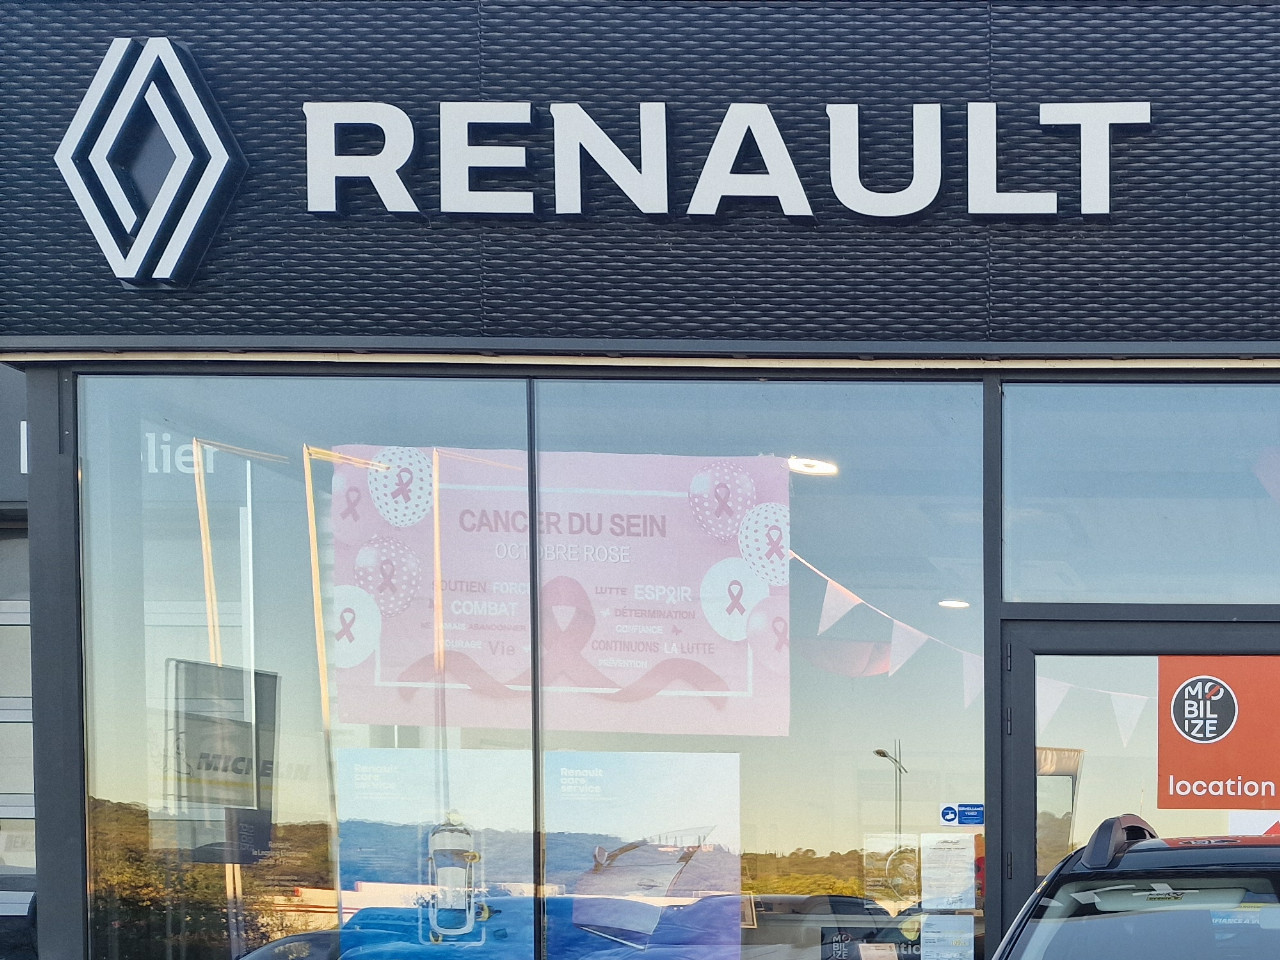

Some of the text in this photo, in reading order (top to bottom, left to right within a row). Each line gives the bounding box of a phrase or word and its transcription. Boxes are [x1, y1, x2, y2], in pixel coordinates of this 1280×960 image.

[303, 102, 1151, 217] RENAULT
[141, 432, 219, 474] lier
[458, 508, 667, 538] CANCER DU SEIN
[584, 544, 632, 563] ROSE
[595, 586, 628, 596] LUTTE
[451, 600, 519, 616] COMBAT
[615, 605, 696, 620] DÉTERMINATION
[615, 624, 664, 635] CONFIANCE
[488, 639, 516, 657] Vie
[591, 639, 715, 655] CONTINUONS LA LUTTE
[560, 767, 603, 778] Renault
[560, 777, 586, 785] care
[560, 784, 602, 794] service
[1169, 774, 1276, 797] location
